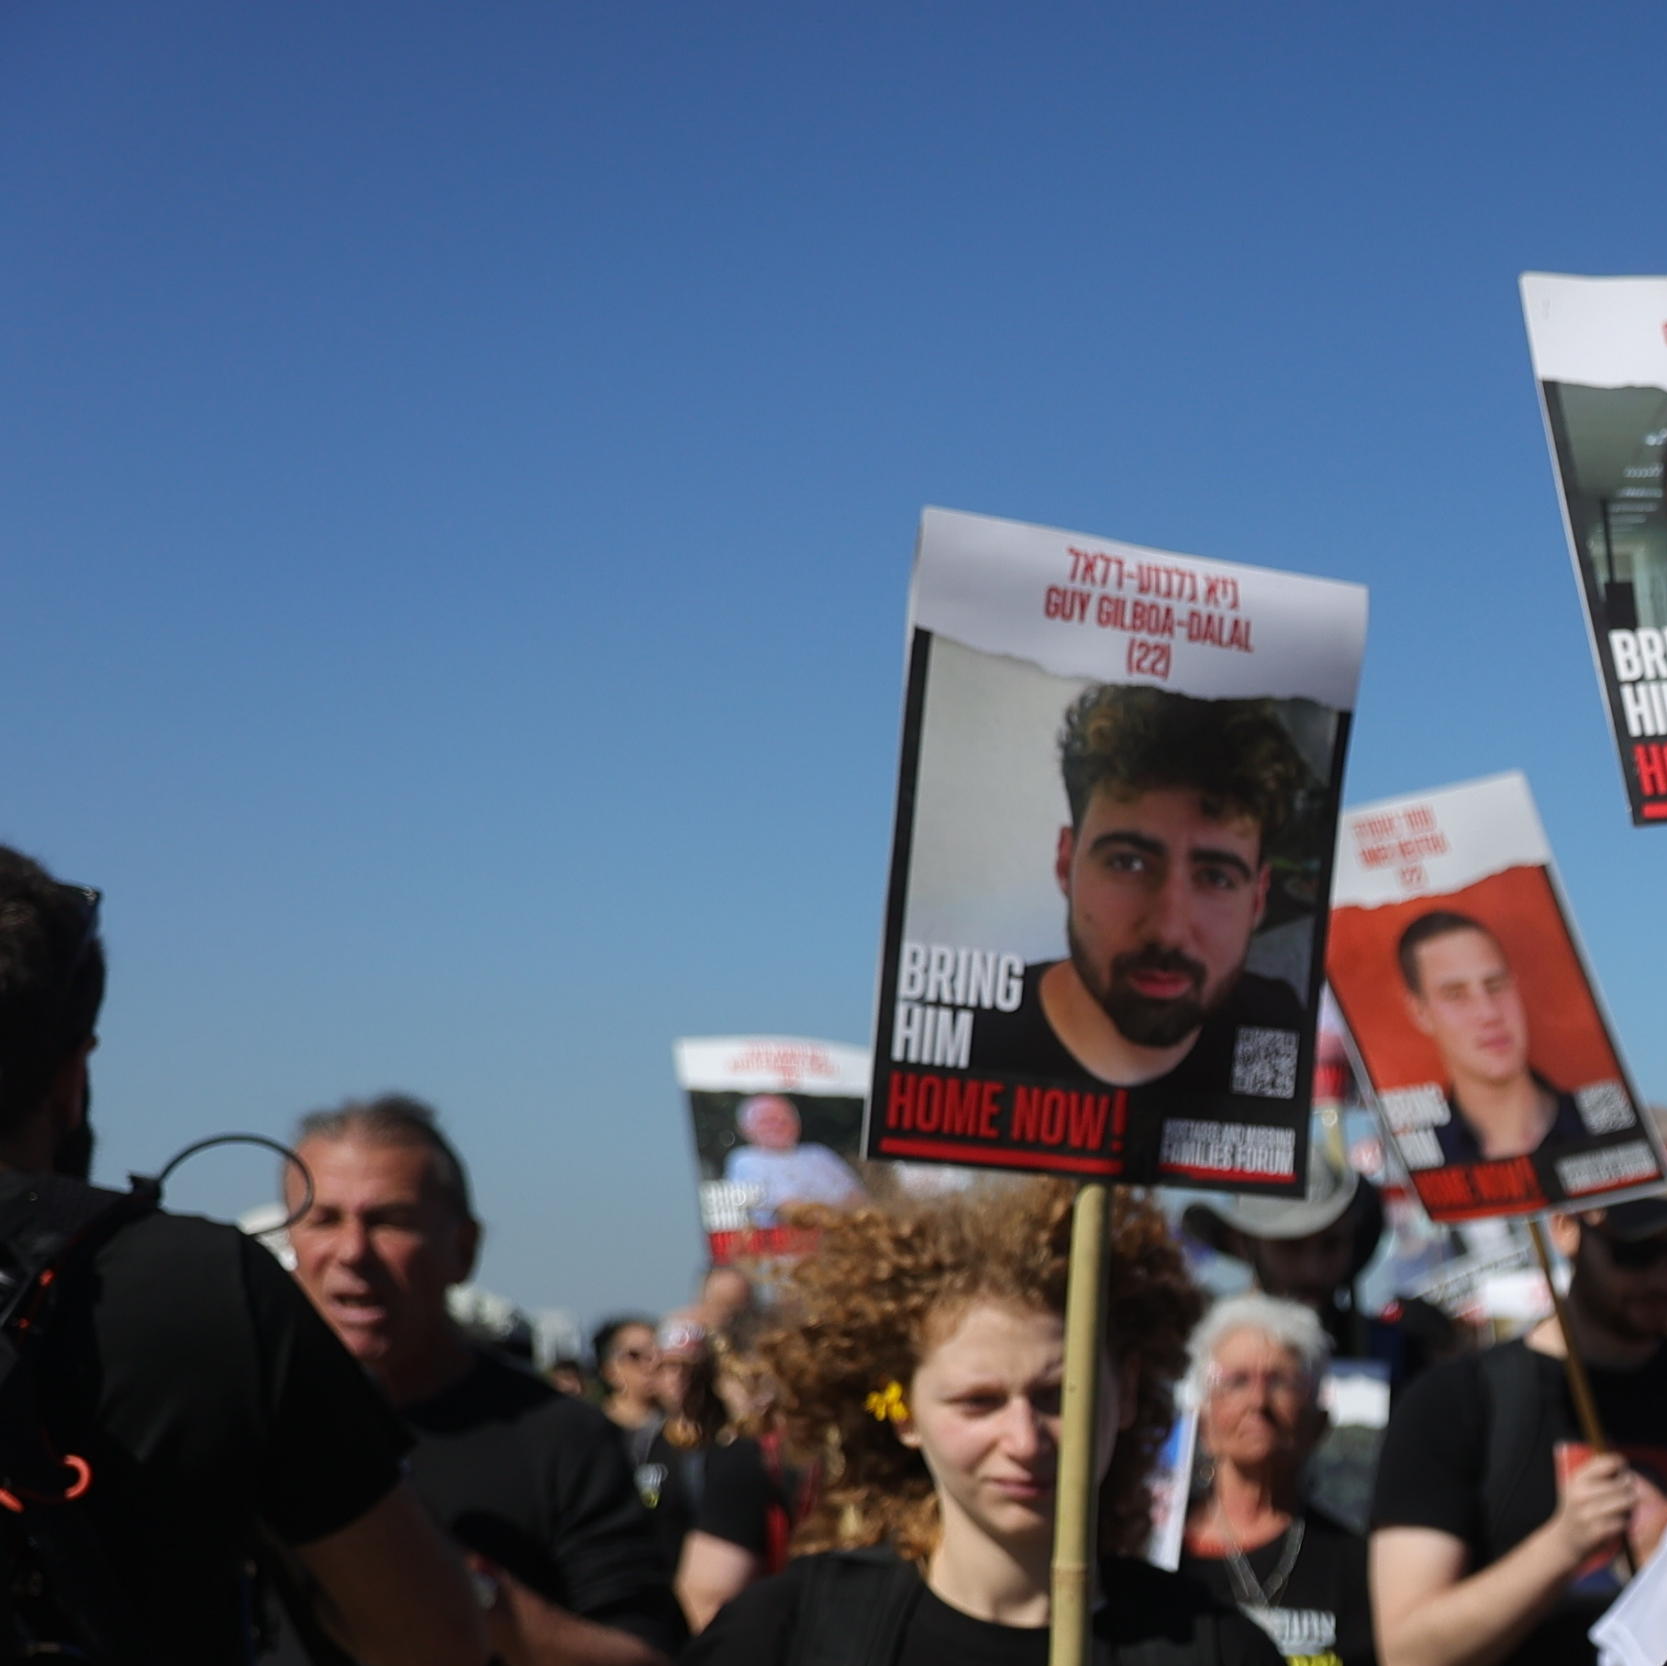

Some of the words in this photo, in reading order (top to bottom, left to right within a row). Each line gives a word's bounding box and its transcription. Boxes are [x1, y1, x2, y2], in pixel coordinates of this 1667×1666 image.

[1045, 586, 1091, 623] GUY
[1096, 593, 1254, 654] GILBOA-DALAL
[1126, 637, 1172, 681] (22)
[899, 940, 1026, 1013] BRING
[890, 1004, 975, 1070] HIM
[886, 1069, 1005, 1140] HOME
[1010, 1084, 1129, 1152] NOW!
